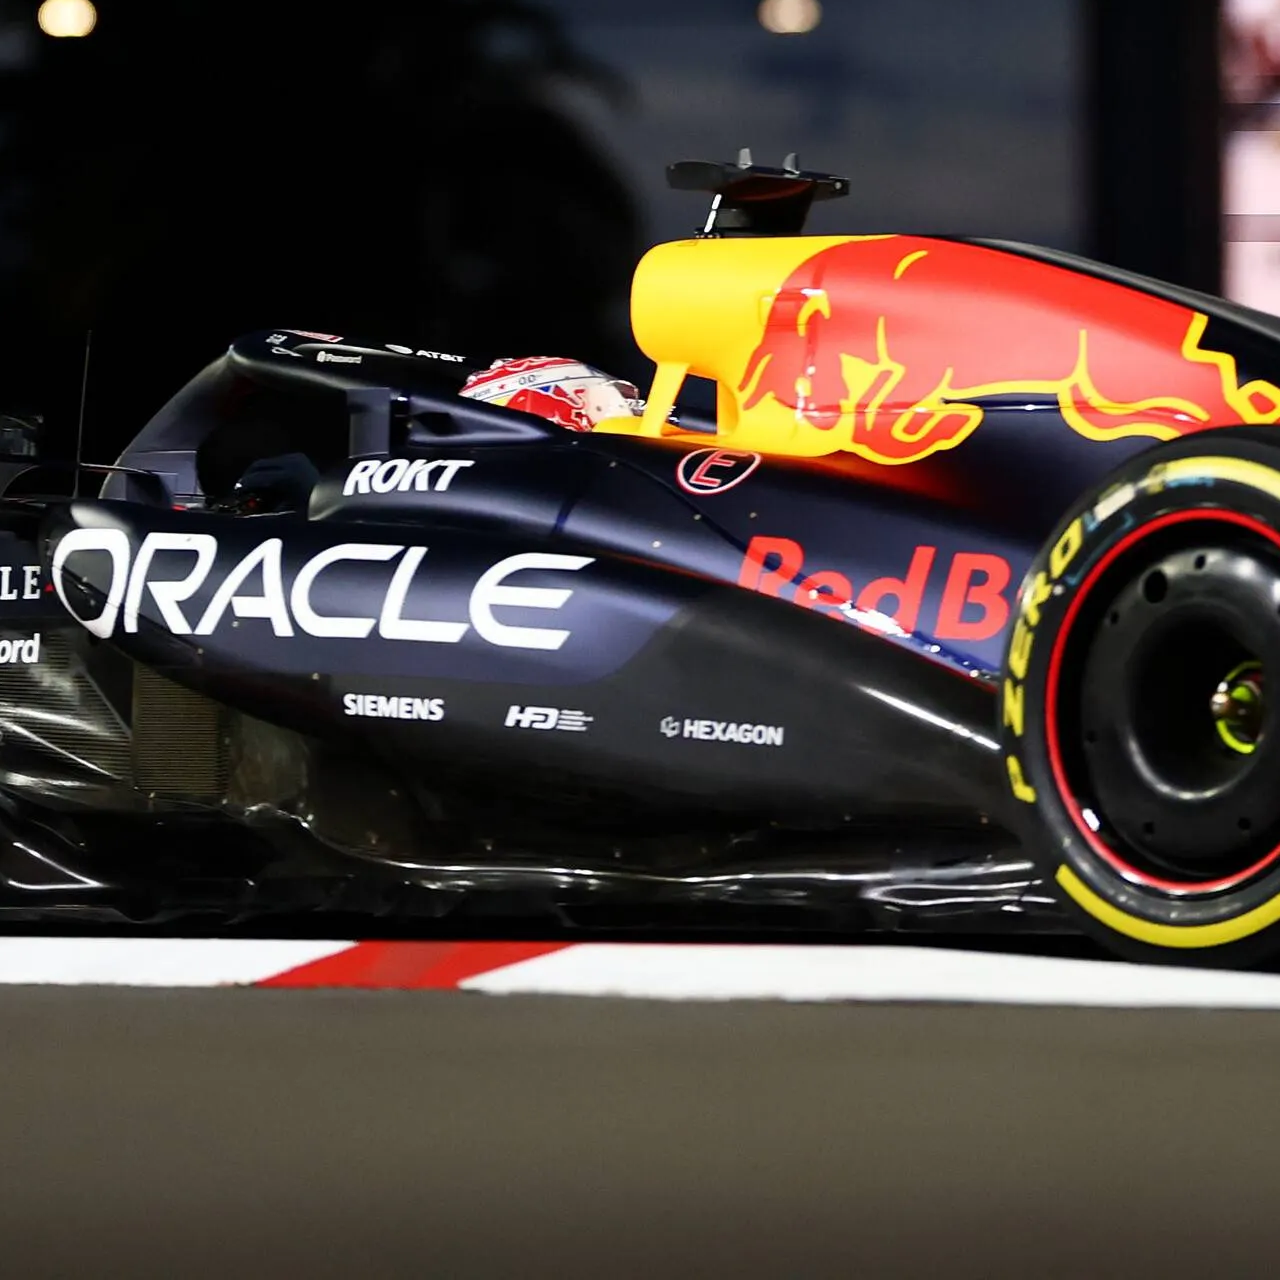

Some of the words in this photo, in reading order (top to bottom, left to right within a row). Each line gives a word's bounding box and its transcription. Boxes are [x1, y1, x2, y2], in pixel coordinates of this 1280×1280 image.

[342, 458, 476, 496] ROKT
[51, 528, 595, 650] ORACLE
[343, 693, 445, 721] SIEMENS
[682, 718, 784, 746] HEXAGON
